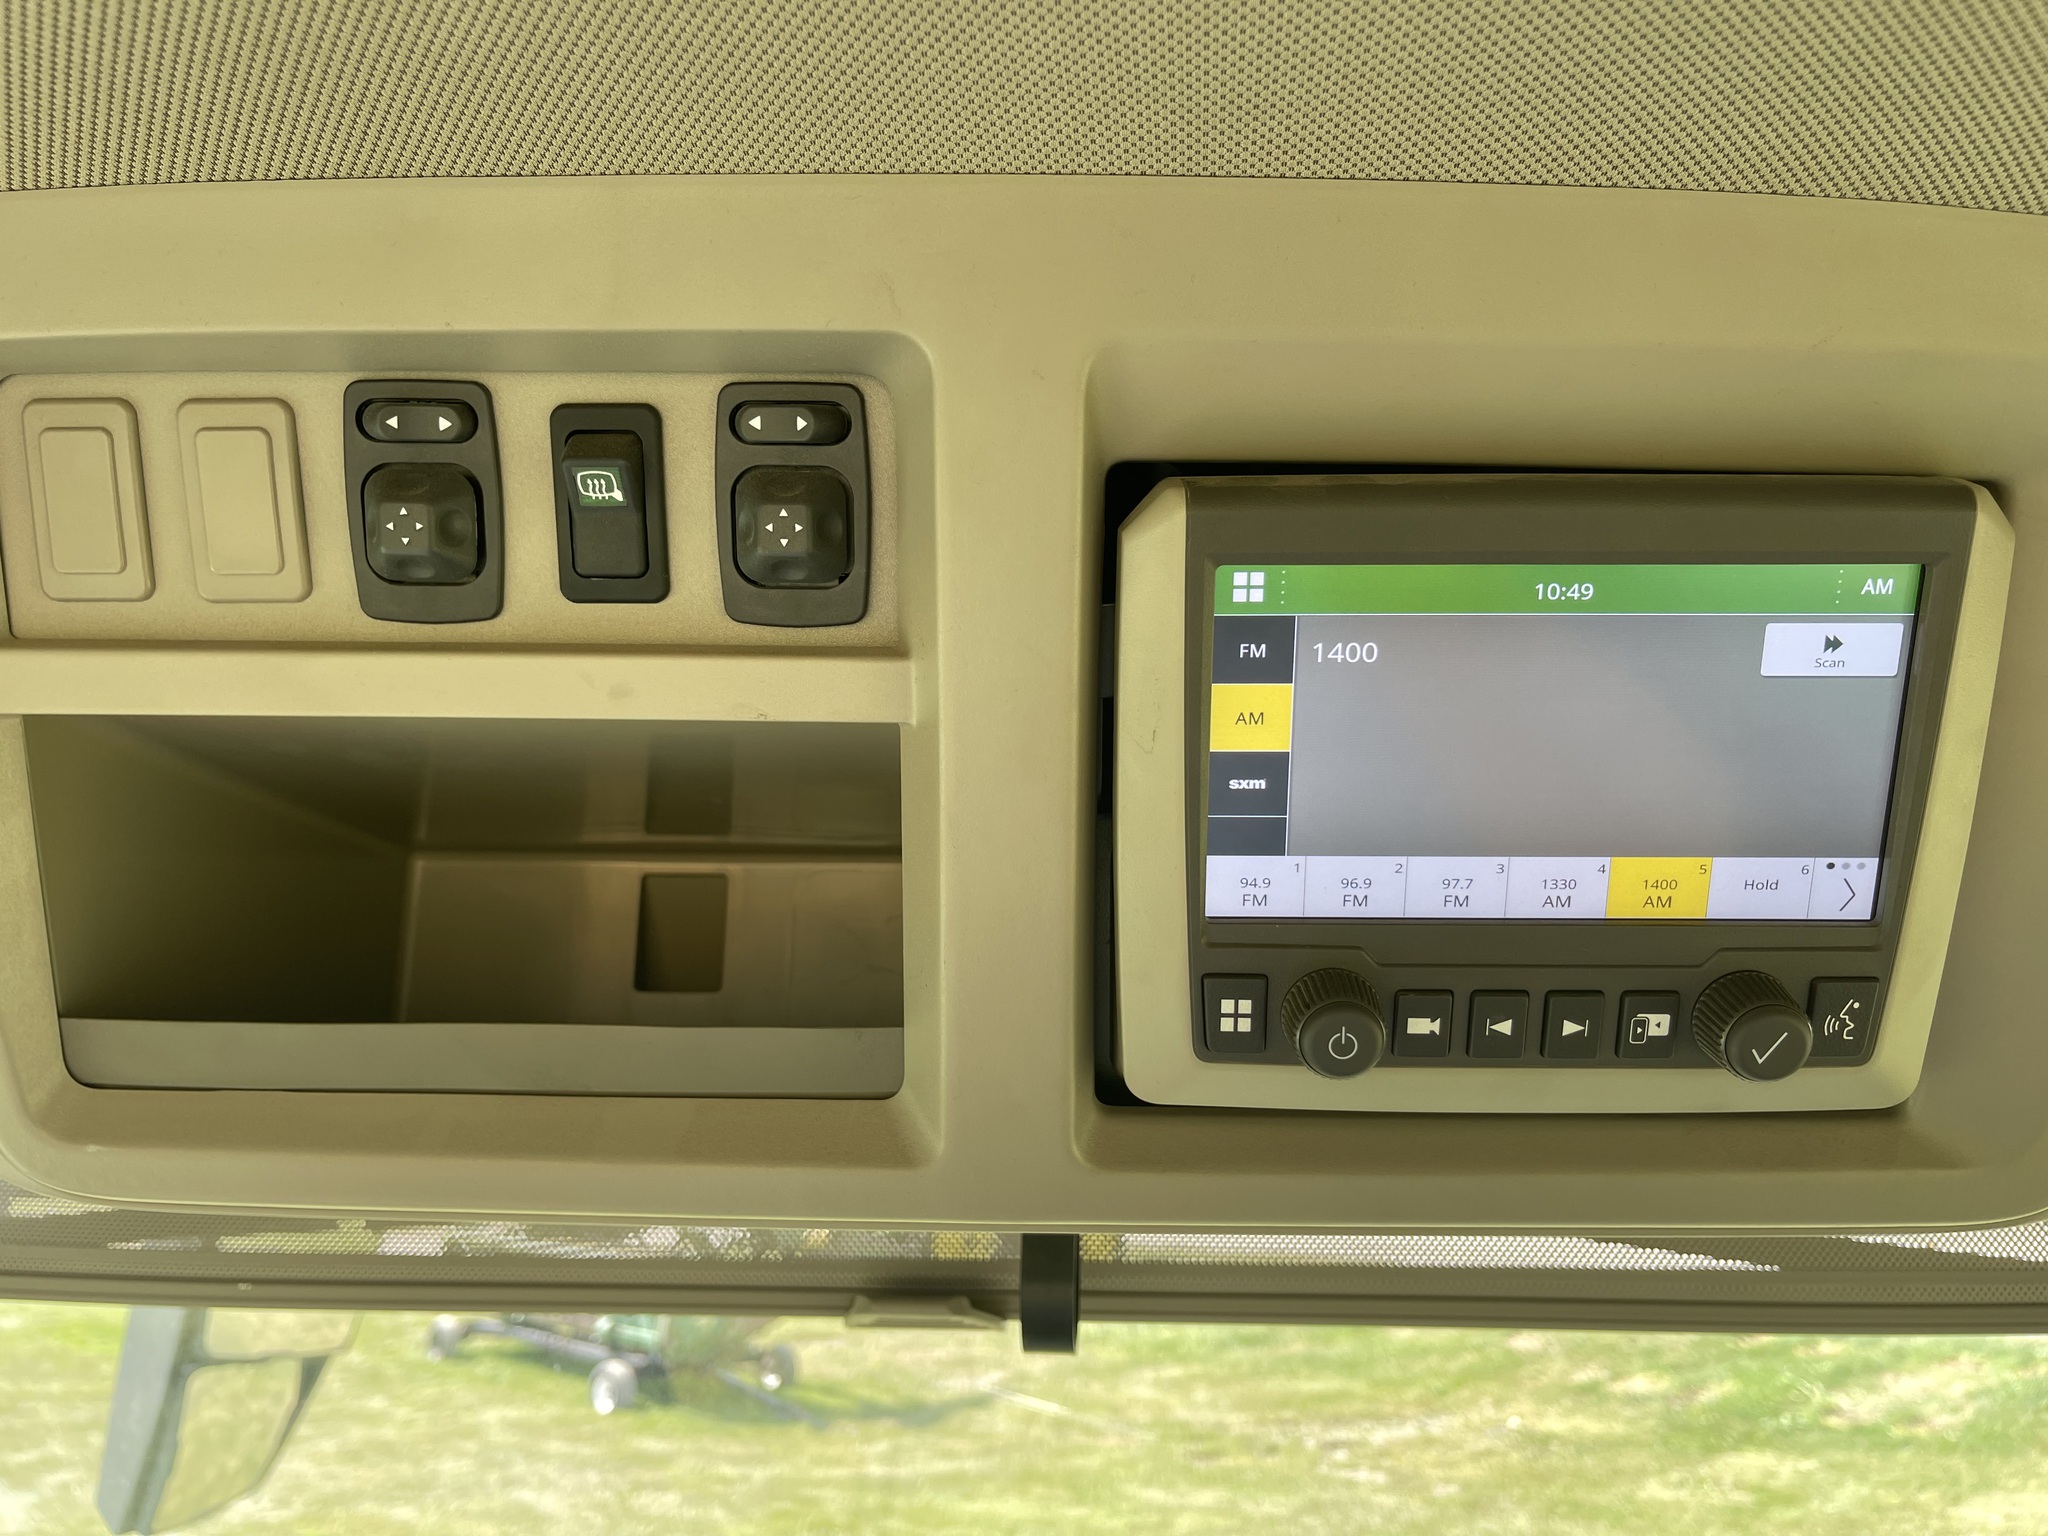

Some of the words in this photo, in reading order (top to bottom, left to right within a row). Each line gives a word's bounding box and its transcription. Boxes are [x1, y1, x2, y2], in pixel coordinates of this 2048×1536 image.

[1535, 582, 1594, 601] 10:49
[1860, 578, 1894, 595] AM
[1239, 643, 1267, 659] FM
[1313, 642, 1378, 663] 1400
[1814, 657, 1845, 668] Scan
[1235, 711, 1264, 726] AM
[1228, 778, 1267, 790] sxm
[1294, 862, 1300, 873] 1
[1394, 863, 1403, 874] 2
[1495, 863, 1505, 874] 3
[1597, 864, 1606, 874] 4
[1699, 864, 1707, 875] 5
[1801, 864, 1810, 875] 6
[1240, 877, 1271, 889] 94.9
[1340, 877, 1372, 889] 96.9
[1442, 878, 1474, 890] 97.7
[1542, 878, 1577, 890] 1330
[1643, 879, 1678, 891] 1400
[1744, 879, 1779, 891] Hold
[1242, 893, 1267, 907] FM
[1342, 894, 1368, 907] FM
[1443, 894, 1469, 908] FM
[1541, 895, 1572, 908] AM
[1642, 895, 1672, 909] AM
